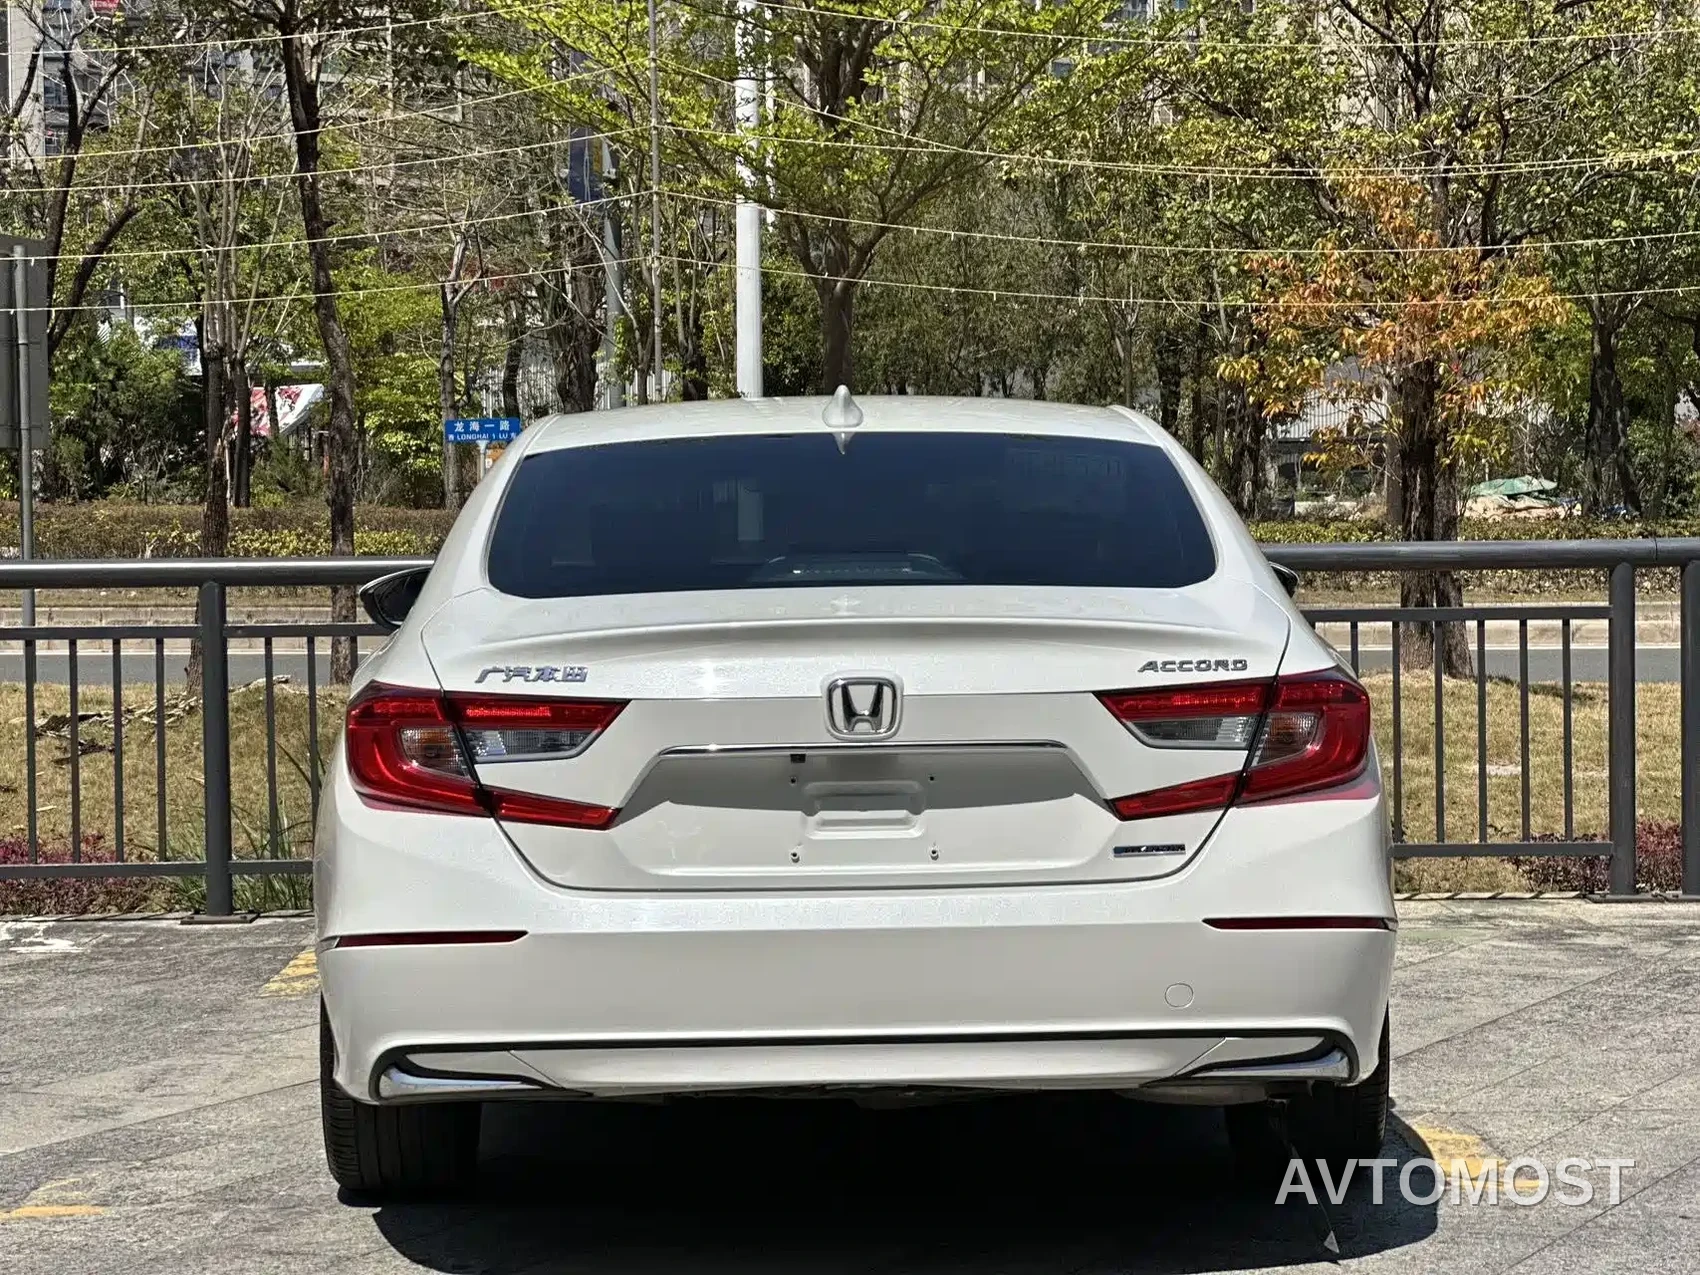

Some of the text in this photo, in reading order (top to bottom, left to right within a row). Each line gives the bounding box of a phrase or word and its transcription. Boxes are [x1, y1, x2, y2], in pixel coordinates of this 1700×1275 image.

[454, 421, 510, 432] 龙海一路
[1137, 659, 1248, 673] ACCORD
[474, 666, 589, 683] 广汽本田
